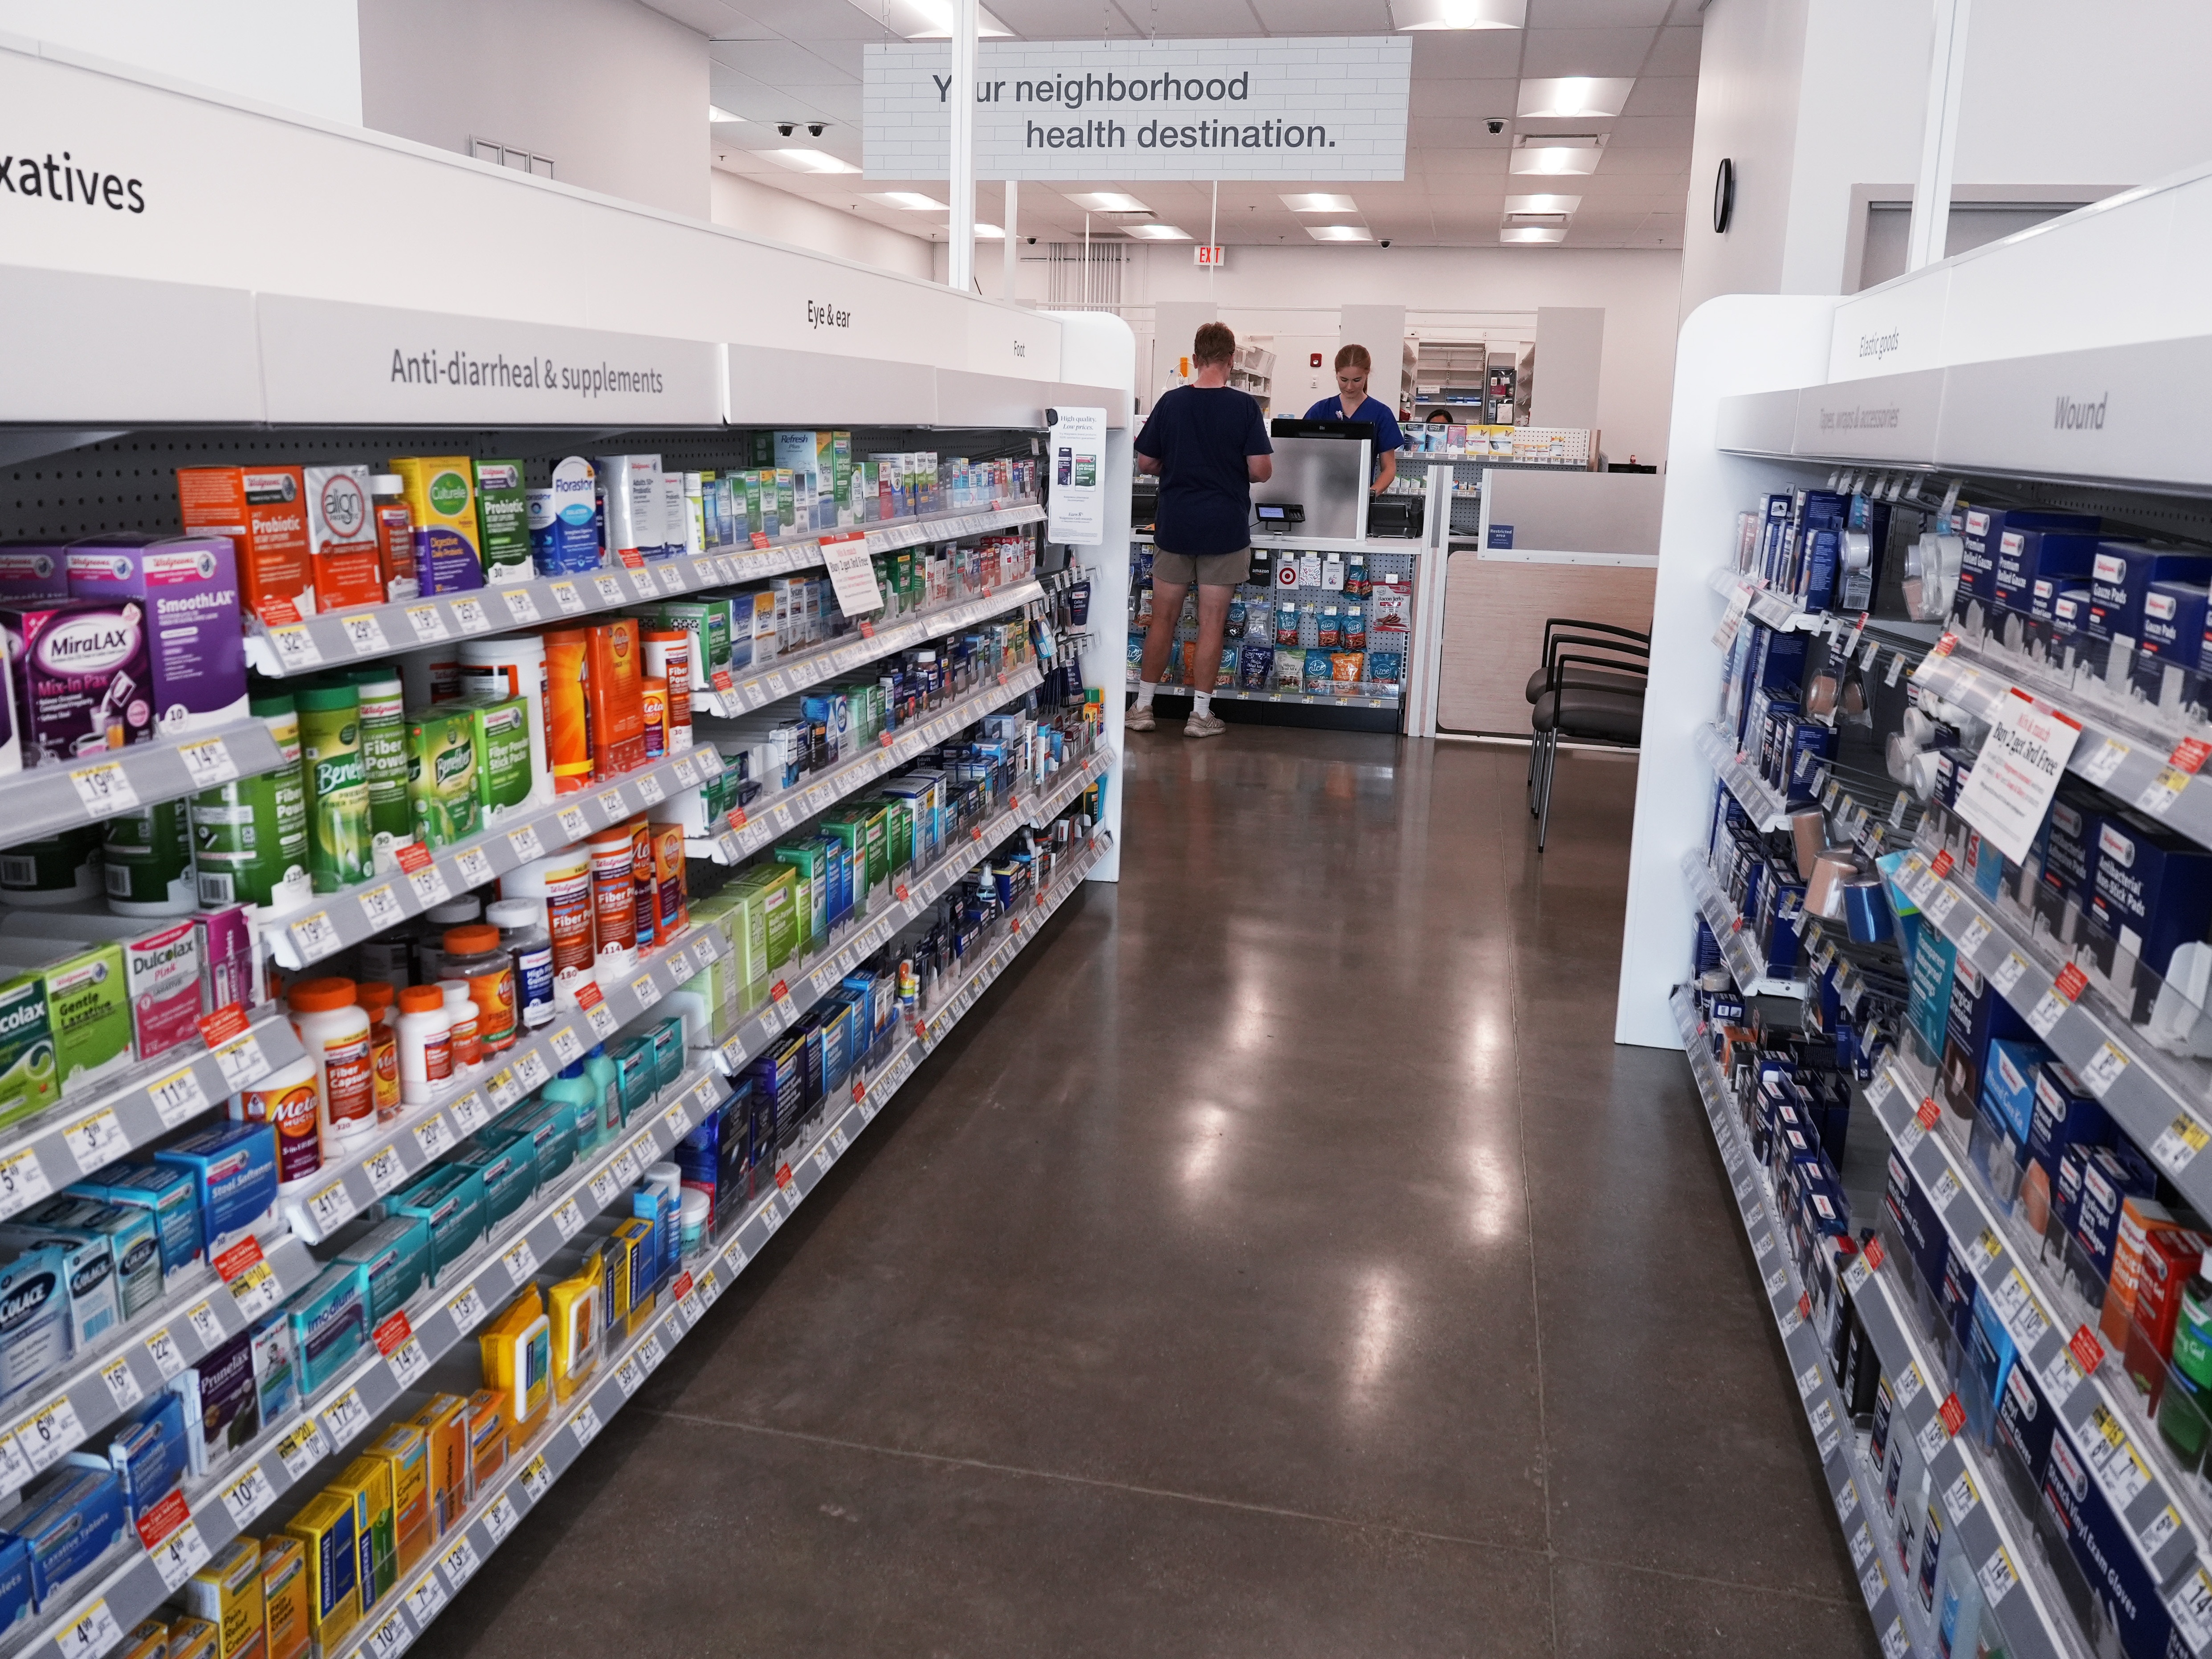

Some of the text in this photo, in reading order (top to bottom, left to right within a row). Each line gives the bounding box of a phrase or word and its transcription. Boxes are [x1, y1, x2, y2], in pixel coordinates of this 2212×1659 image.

[933, 71, 1250, 110] Yur neighborhood
[1027, 117, 1336, 149] health destination.
[1199, 247, 1221, 263] EXT
[807, 300, 851, 330] Eye & ear
[1014, 340, 1025, 358] Foot
[1859, 326, 1899, 359] Elastic goods
[391, 348, 663, 399] Anti-diarrheal & supplements
[1076, 415, 1097, 423] quality.
[2053, 391, 2109, 431] Wound
[781, 435, 808, 444] Refresh
[555, 478, 593, 493] Florastor
[252, 516, 301, 534] Probiotic
[829, 561, 840, 574] Buy
[51, 628, 126, 657] MiraLAX
[1992, 722, 2009, 748] Buy
[134, 938, 194, 976] Dulcolax
